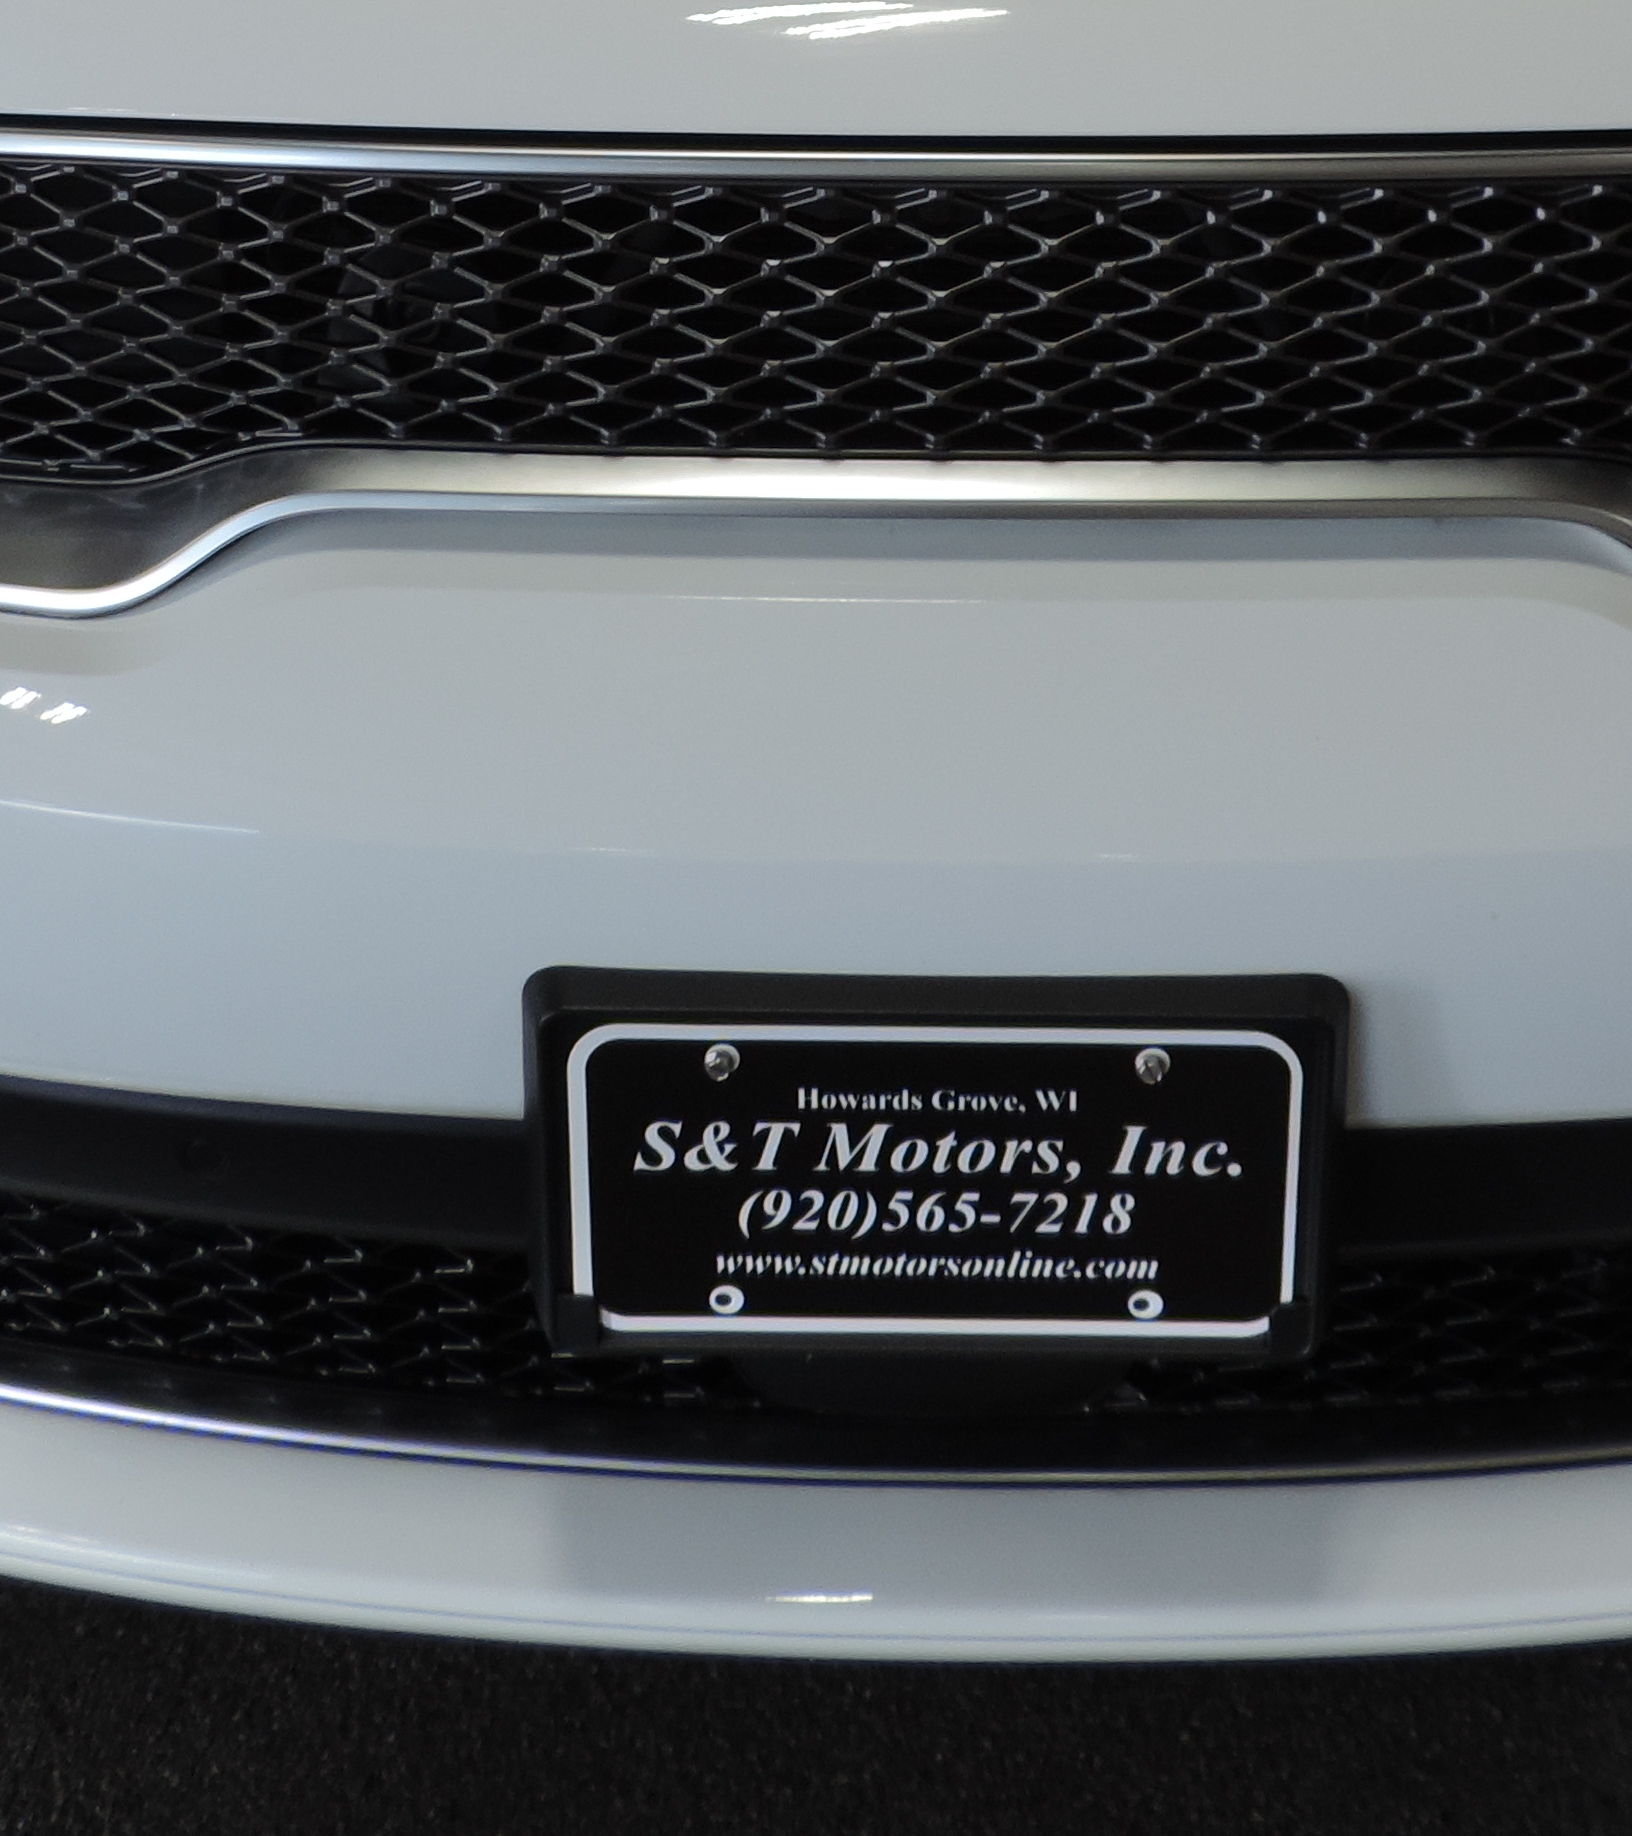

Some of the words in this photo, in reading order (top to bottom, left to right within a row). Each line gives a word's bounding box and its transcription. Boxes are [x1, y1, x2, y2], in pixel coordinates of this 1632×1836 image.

[798, 1088, 922, 1110] Howards
[932, 1091, 1025, 1112] Grove,
[1036, 1090, 1076, 1111] WI
[634, 1121, 800, 1171] S&T
[815, 1123, 1080, 1182] Motors,
[1112, 1126, 1241, 1176] Inc.
[739, 1190, 1135, 1239] (920)565-7218
[717, 1251, 1158, 1279] www.stmotorsonline.com
